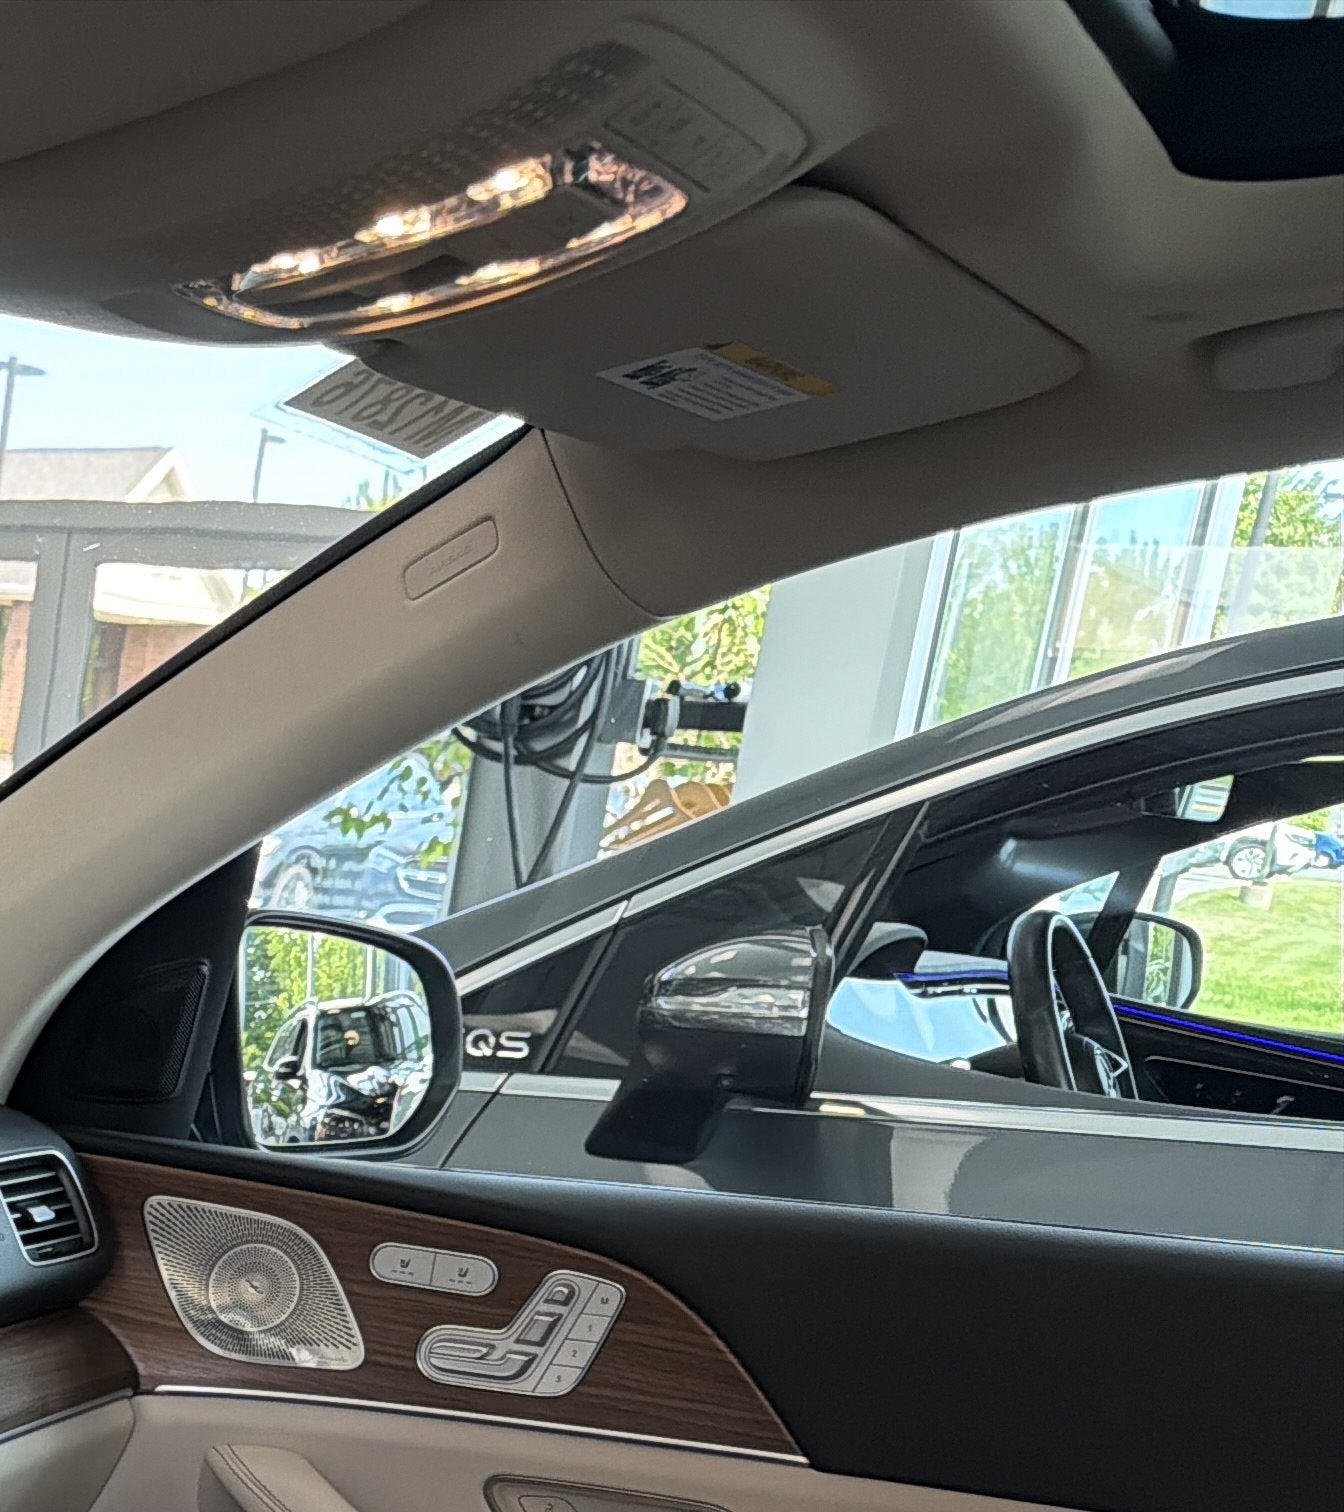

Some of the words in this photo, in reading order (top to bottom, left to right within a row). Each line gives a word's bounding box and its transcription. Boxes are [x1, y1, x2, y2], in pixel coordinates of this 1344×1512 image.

[462, 1027, 532, 1059] QS
[571, 1349, 579, 1358] 2
[554, 1374, 562, 1383] 3
